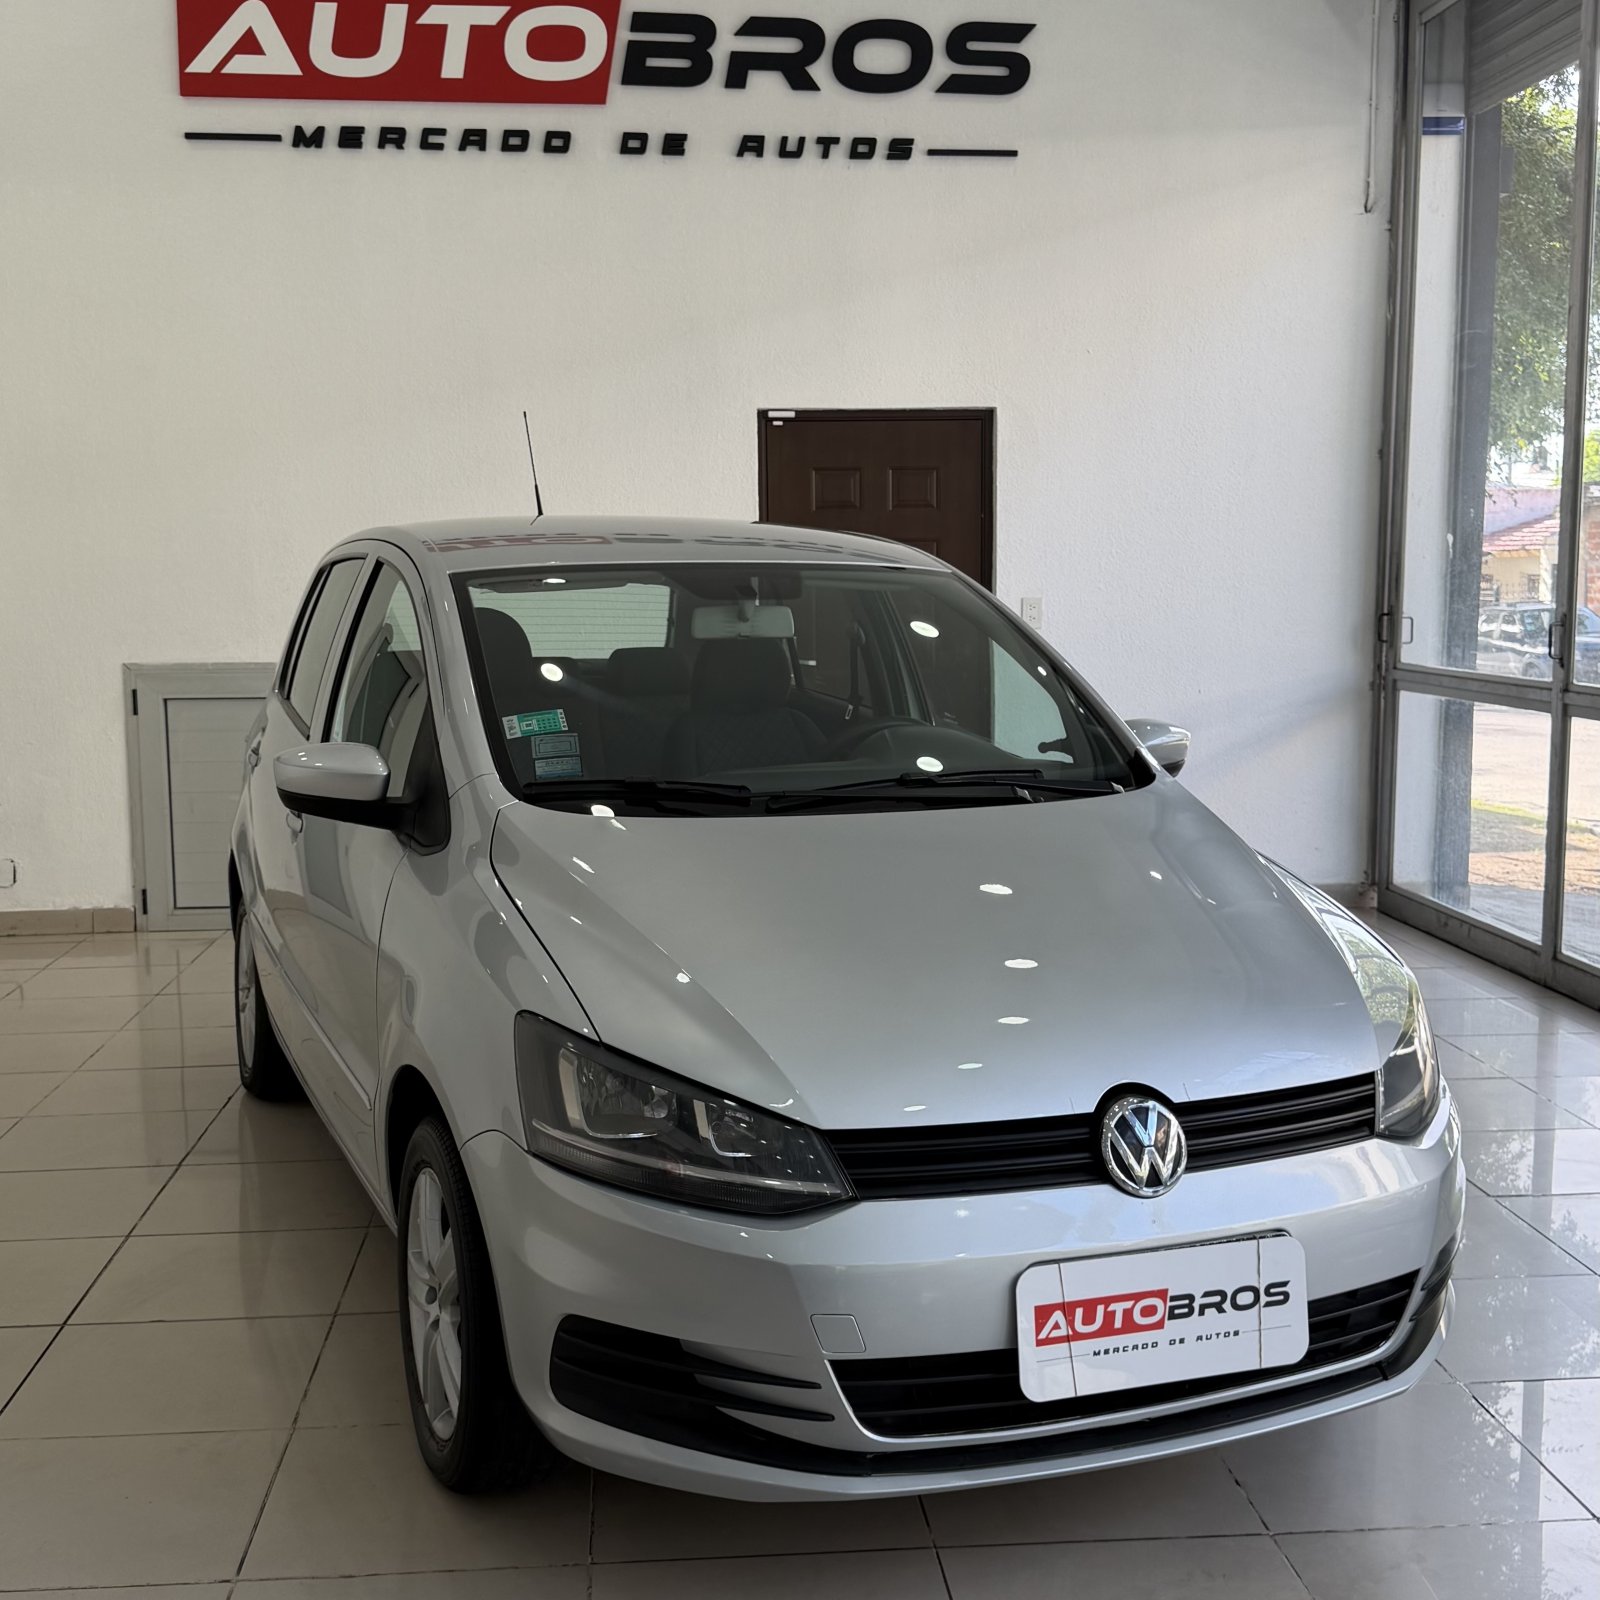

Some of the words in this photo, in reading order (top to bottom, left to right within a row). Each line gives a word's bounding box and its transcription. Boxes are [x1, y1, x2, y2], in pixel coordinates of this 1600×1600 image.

[291, 125, 572, 154] MERCADO
[619, 131, 688, 157] DE
[736, 134, 915, 161] AUTOS
[1092, 1340, 1159, 1357] MERCADO
[1168, 1337, 1186, 1346] DE
[1195, 1329, 1241, 1342] AUTOS
